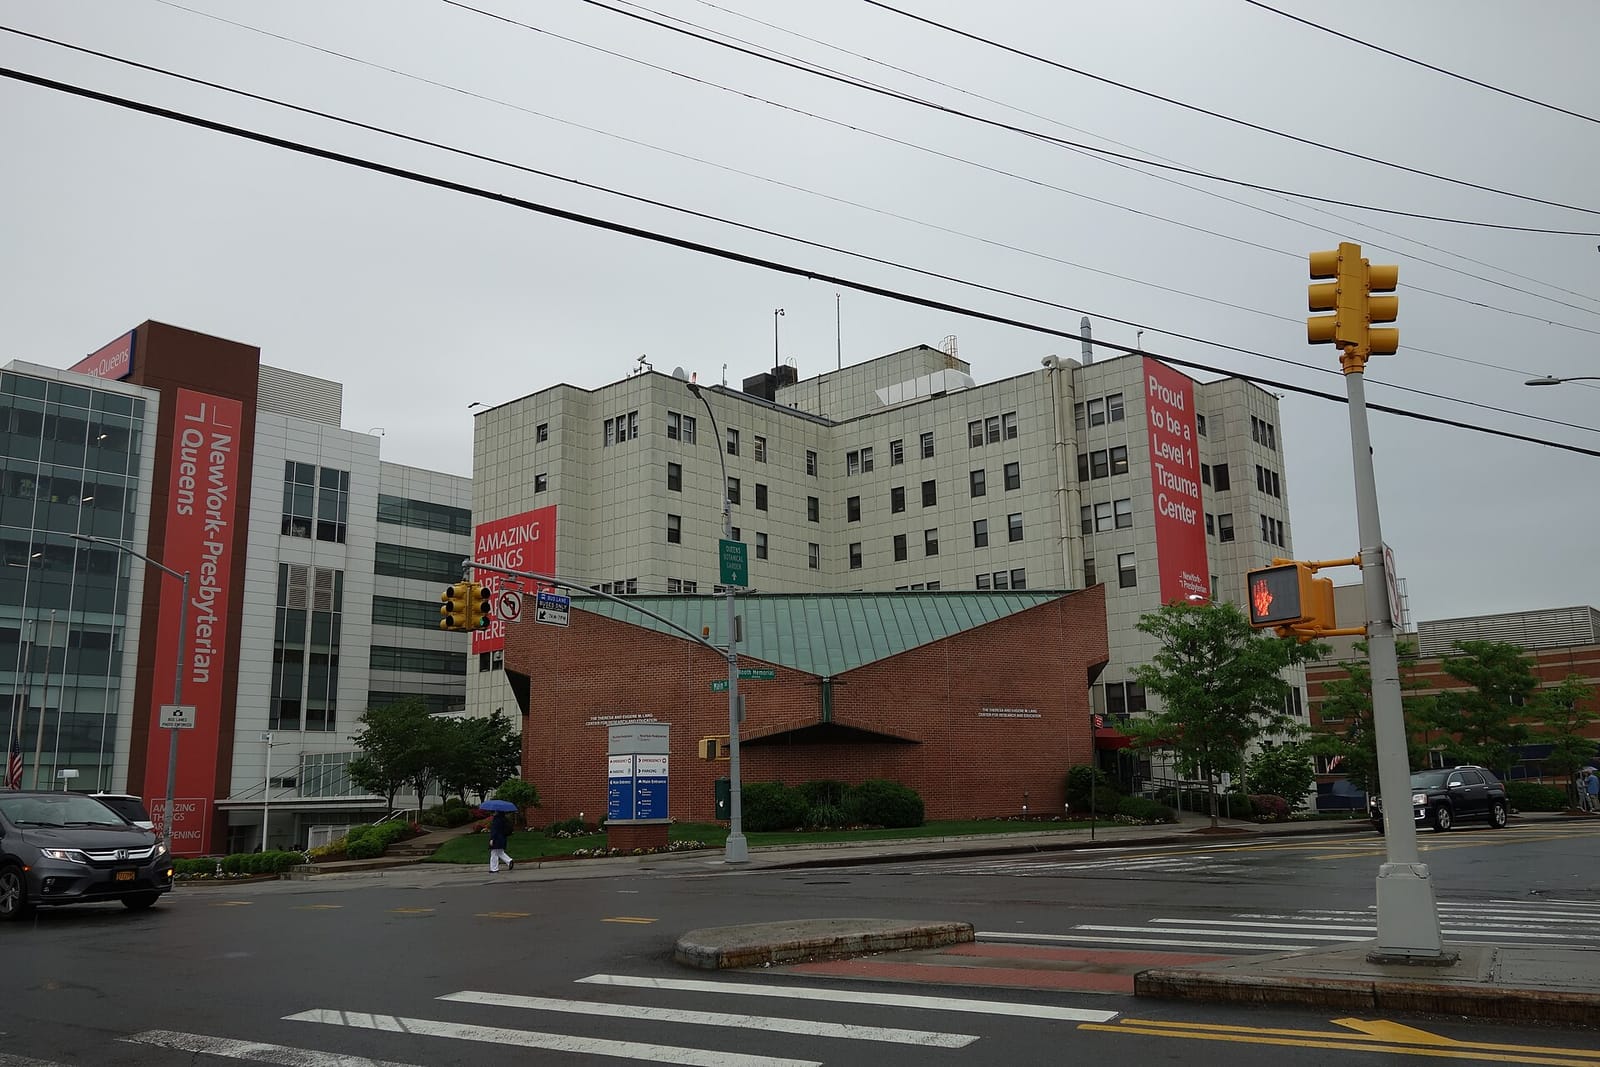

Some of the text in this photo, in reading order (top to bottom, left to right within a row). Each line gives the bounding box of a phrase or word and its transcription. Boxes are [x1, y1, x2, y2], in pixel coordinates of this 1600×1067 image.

[98, 348, 129, 376] Queens
[1149, 375, 1184, 411] Proud
[1151, 405, 1191, 441] to be a
[1153, 434, 1193, 469] Level 1
[177, 428, 205, 516] Queens
[1155, 461, 1199, 500] Trauma
[1158, 491, 1197, 526] Center
[477, 522, 540, 554] AMAZING
[192, 431, 232, 684] NewYork-Presbyterian
[477, 548, 523, 575] THINGS
[1183, 580, 1207, 593] Presbyterian
[152, 812, 184, 822] THGS
[153, 803, 195, 812] AMZING
[156, 830, 200, 840] APENING
